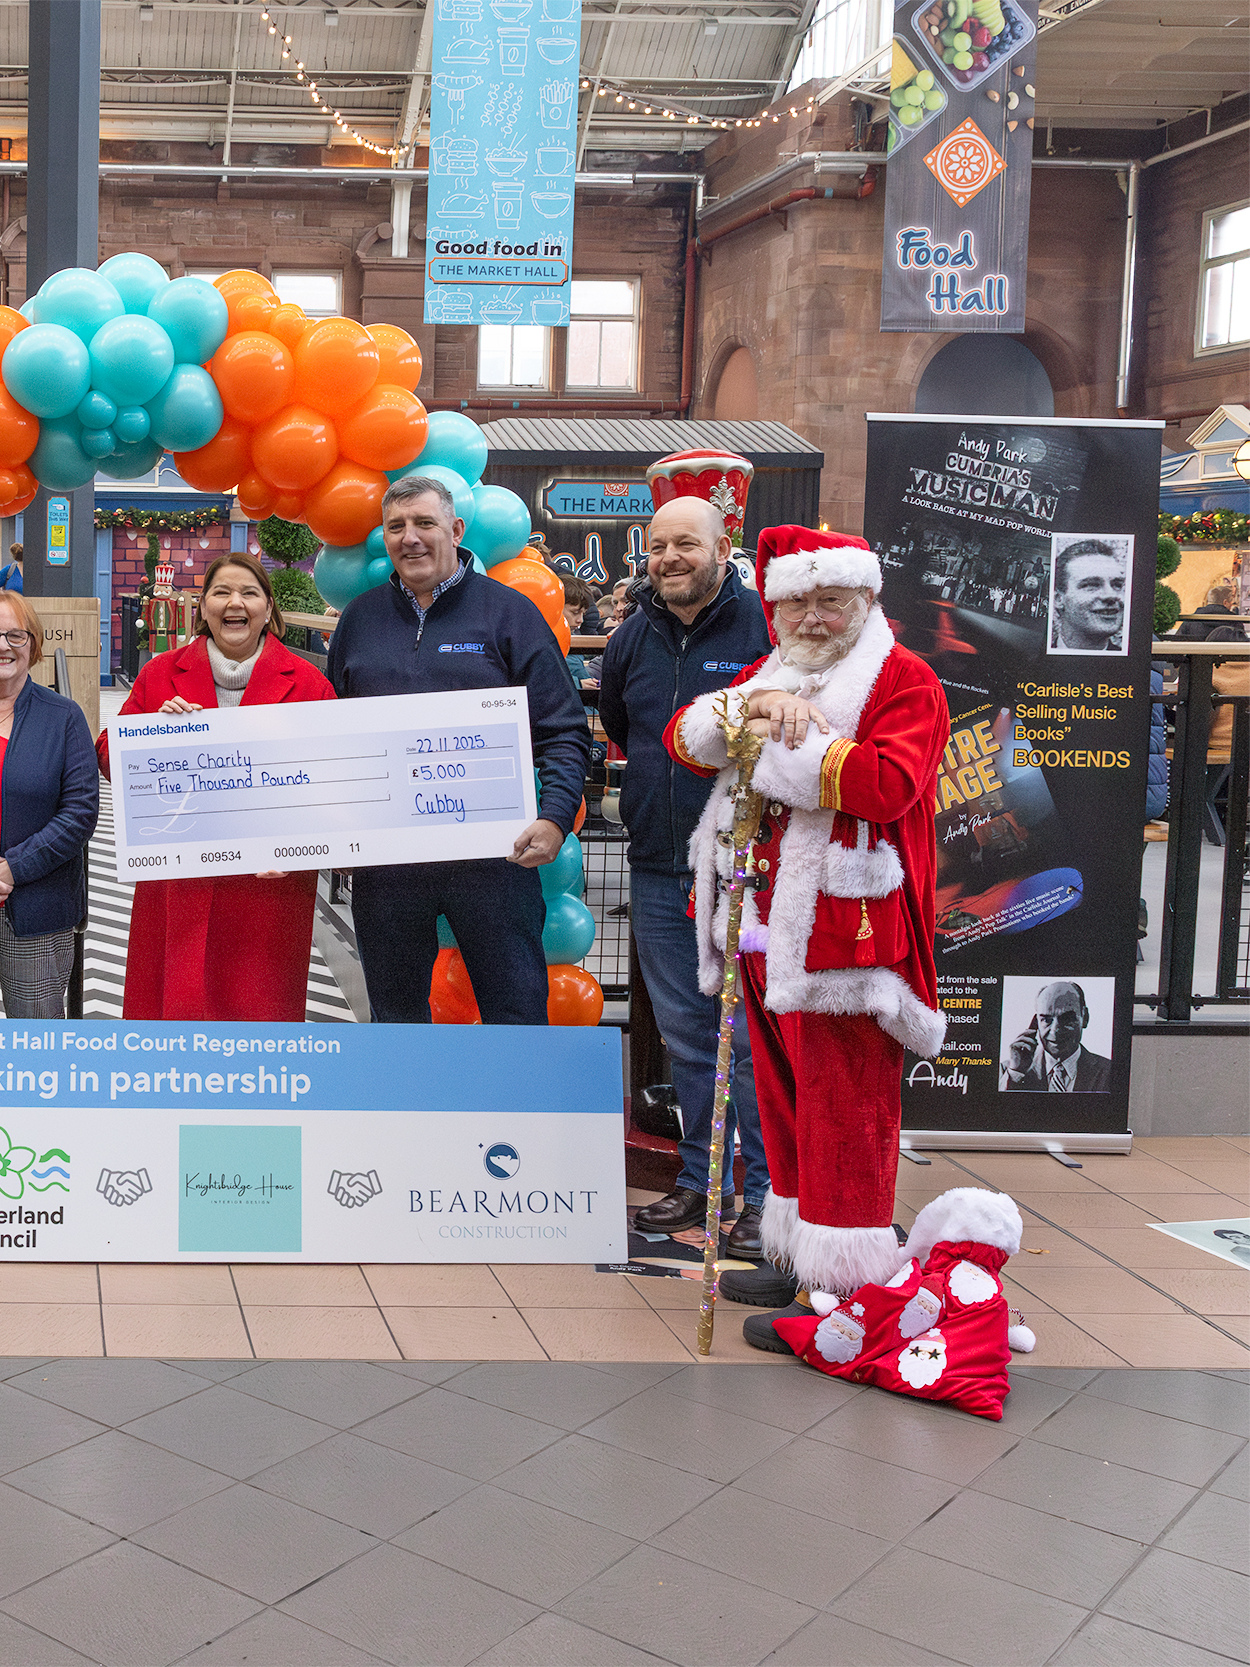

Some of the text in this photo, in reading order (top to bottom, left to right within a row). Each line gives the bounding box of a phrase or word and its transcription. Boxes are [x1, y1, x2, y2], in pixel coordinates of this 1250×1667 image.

[435, 240, 562, 256] Good food in
[897, 228, 977, 270] Food
[438, 265, 558, 277] THE MARKET HALL
[926, 272, 1008, 314] Hall
[958, 431, 1028, 463] Andy Park
[945, 452, 1031, 489] CUMBRIA'S
[906, 467, 1058, 521] MUSIC MAN
[560, 498, 653, 513] THE MARK
[901, 495, 1053, 538] A LOOK BACK AT MY MAD POP WORLD
[44, 629, 73, 641] USH
[453, 643, 485, 651] CUBBY
[1097, 683, 1134, 699] Best
[481, 699, 517, 709] 60-95-34
[1015, 703, 1117, 723] Selling Music
[118, 722, 210, 738] Handelsbanken
[147, 758, 189, 773] Sense
[197, 750, 252, 773] Charity
[1013, 748, 1131, 769] BOOKENDS
[157, 776, 182, 795] Five
[187, 772, 253, 792] Thousand
[261, 770, 311, 787] Pounds
[415, 793, 466, 822] Cubby
[943, 812, 991, 844] Andy Park
[127, 842, 361, 868] 000001 1 609534 00000000 11
[982, 914, 995, 922] back
[968, 935, 980, 943] Andy
[946, 975, 965, 984] from
[966, 975, 980, 984] the
[980, 975, 998, 985] sale
[954, 986, 964, 994] to
[964, 986, 978, 995] the
[943, 998, 982, 1009] CENTRE
[12, 1031, 55, 1050] Hall
[62, 1031, 117, 1051] Food
[123, 1032, 187, 1052] Court
[193, 1033, 341, 1057] Regeneration
[935, 1056, 992, 1067] Many Thanks
[69, 1063, 99, 1092] in
[111, 1065, 312, 1102] partnership
[905, 1060, 968, 1095] Andy
[185, 1172, 294, 1198] Knightsbridge House
[408, 1189, 598, 1218] BEARMONT
[438, 1225, 568, 1239] CONSTRUCTION
